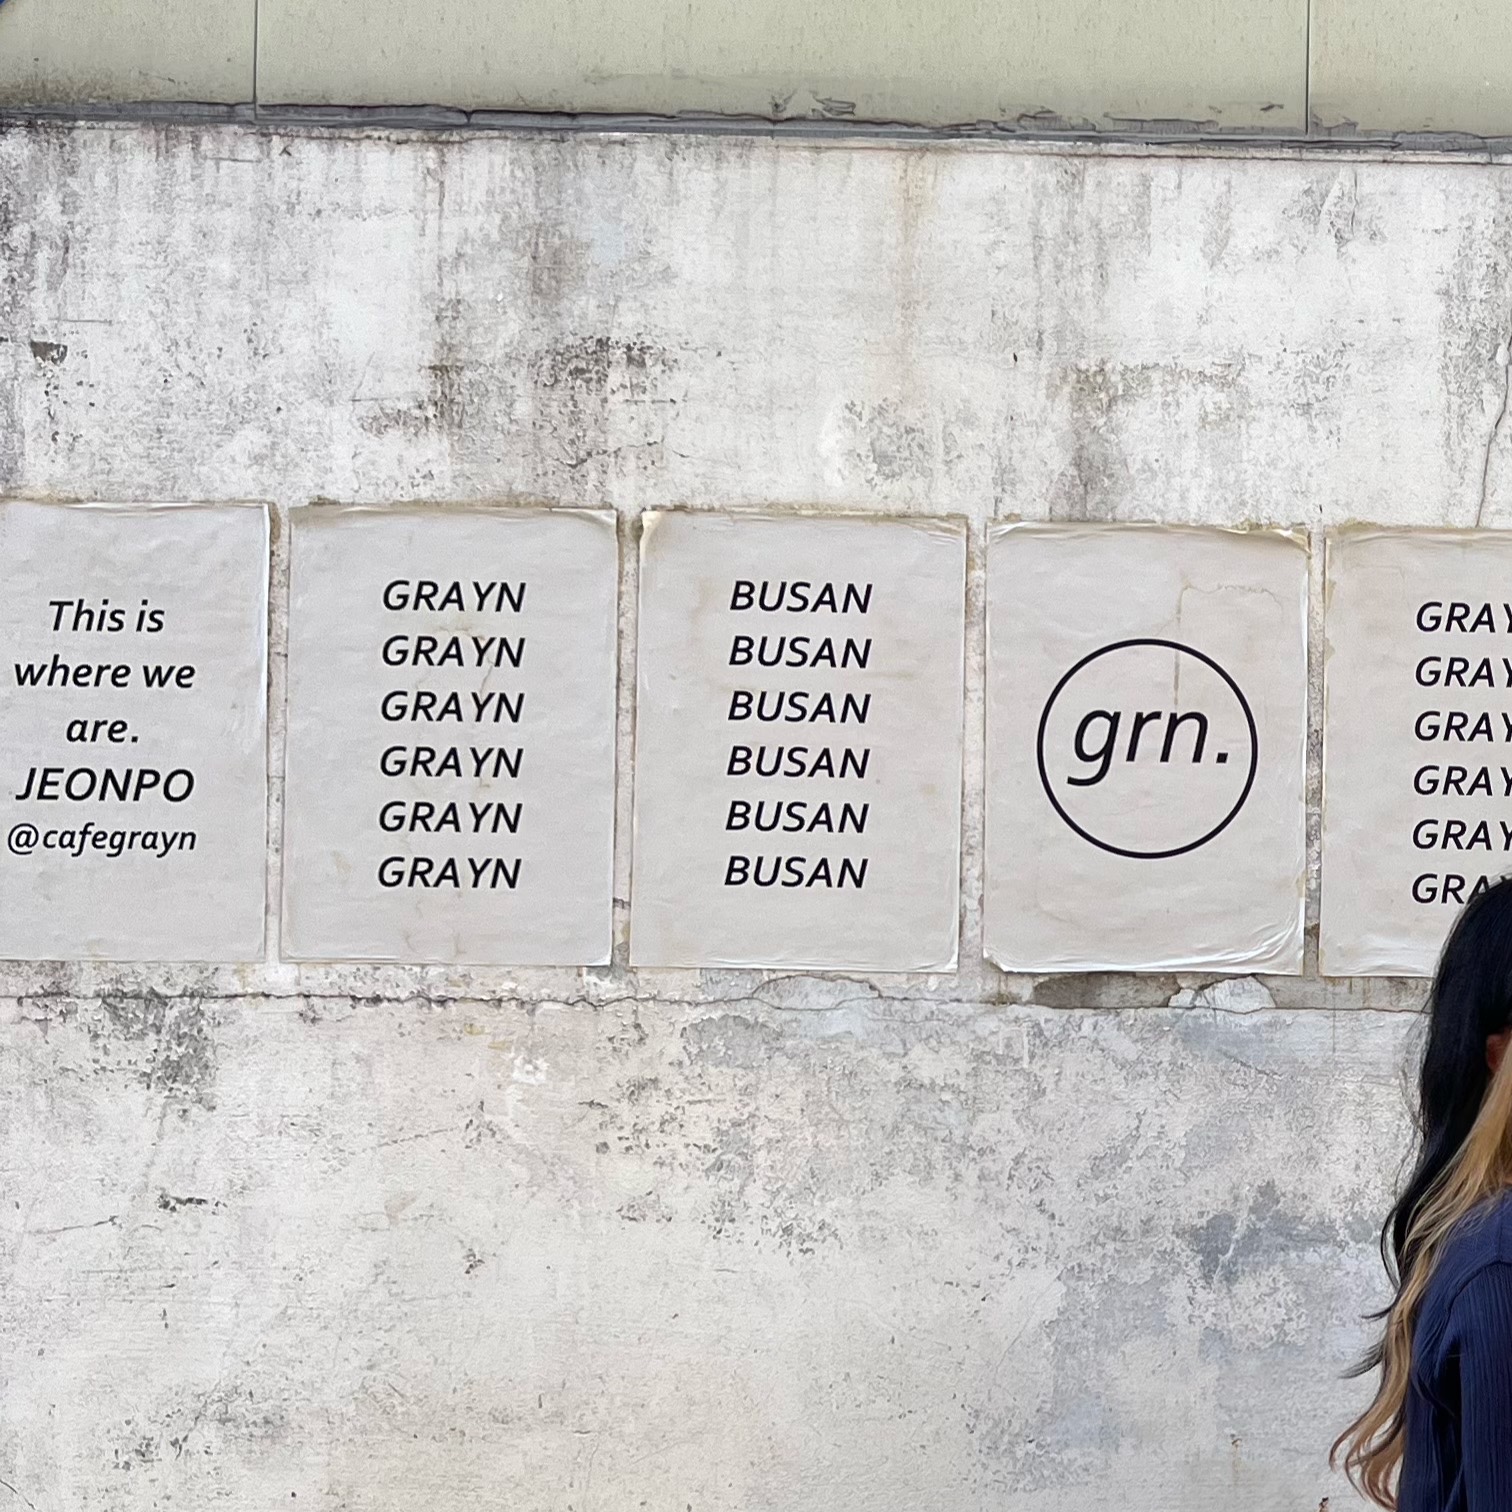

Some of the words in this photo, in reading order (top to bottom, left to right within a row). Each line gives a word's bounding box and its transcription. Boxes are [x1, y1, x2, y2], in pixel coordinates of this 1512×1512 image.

[383, 579, 527, 613] GRAYN
[729, 580, 873, 614] BUSAN
[49, 598, 126, 632] This
[135, 599, 165, 633] is
[382, 635, 526, 668] GRAYN
[728, 635, 872, 669] BUSAN
[14, 653, 131, 688] where
[142, 665, 196, 689] we
[381, 690, 525, 723] GRAYN
[727, 690, 872, 724] BUSAN
[66, 719, 139, 743] are.
[1066, 709, 1229, 787] grn.
[380, 745, 524, 779] GRAYN
[726, 745, 871, 779] BUSAN
[15, 767, 195, 803] JEONPO
[379, 800, 523, 834] GRAYN
[725, 800, 870, 834] BUSAN
[7, 821, 197, 859] @cafegrayn
[378, 856, 522, 889] GRAYN
[724, 855, 869, 889] BUSAN
[1411, 872, 1508, 904] GRA
